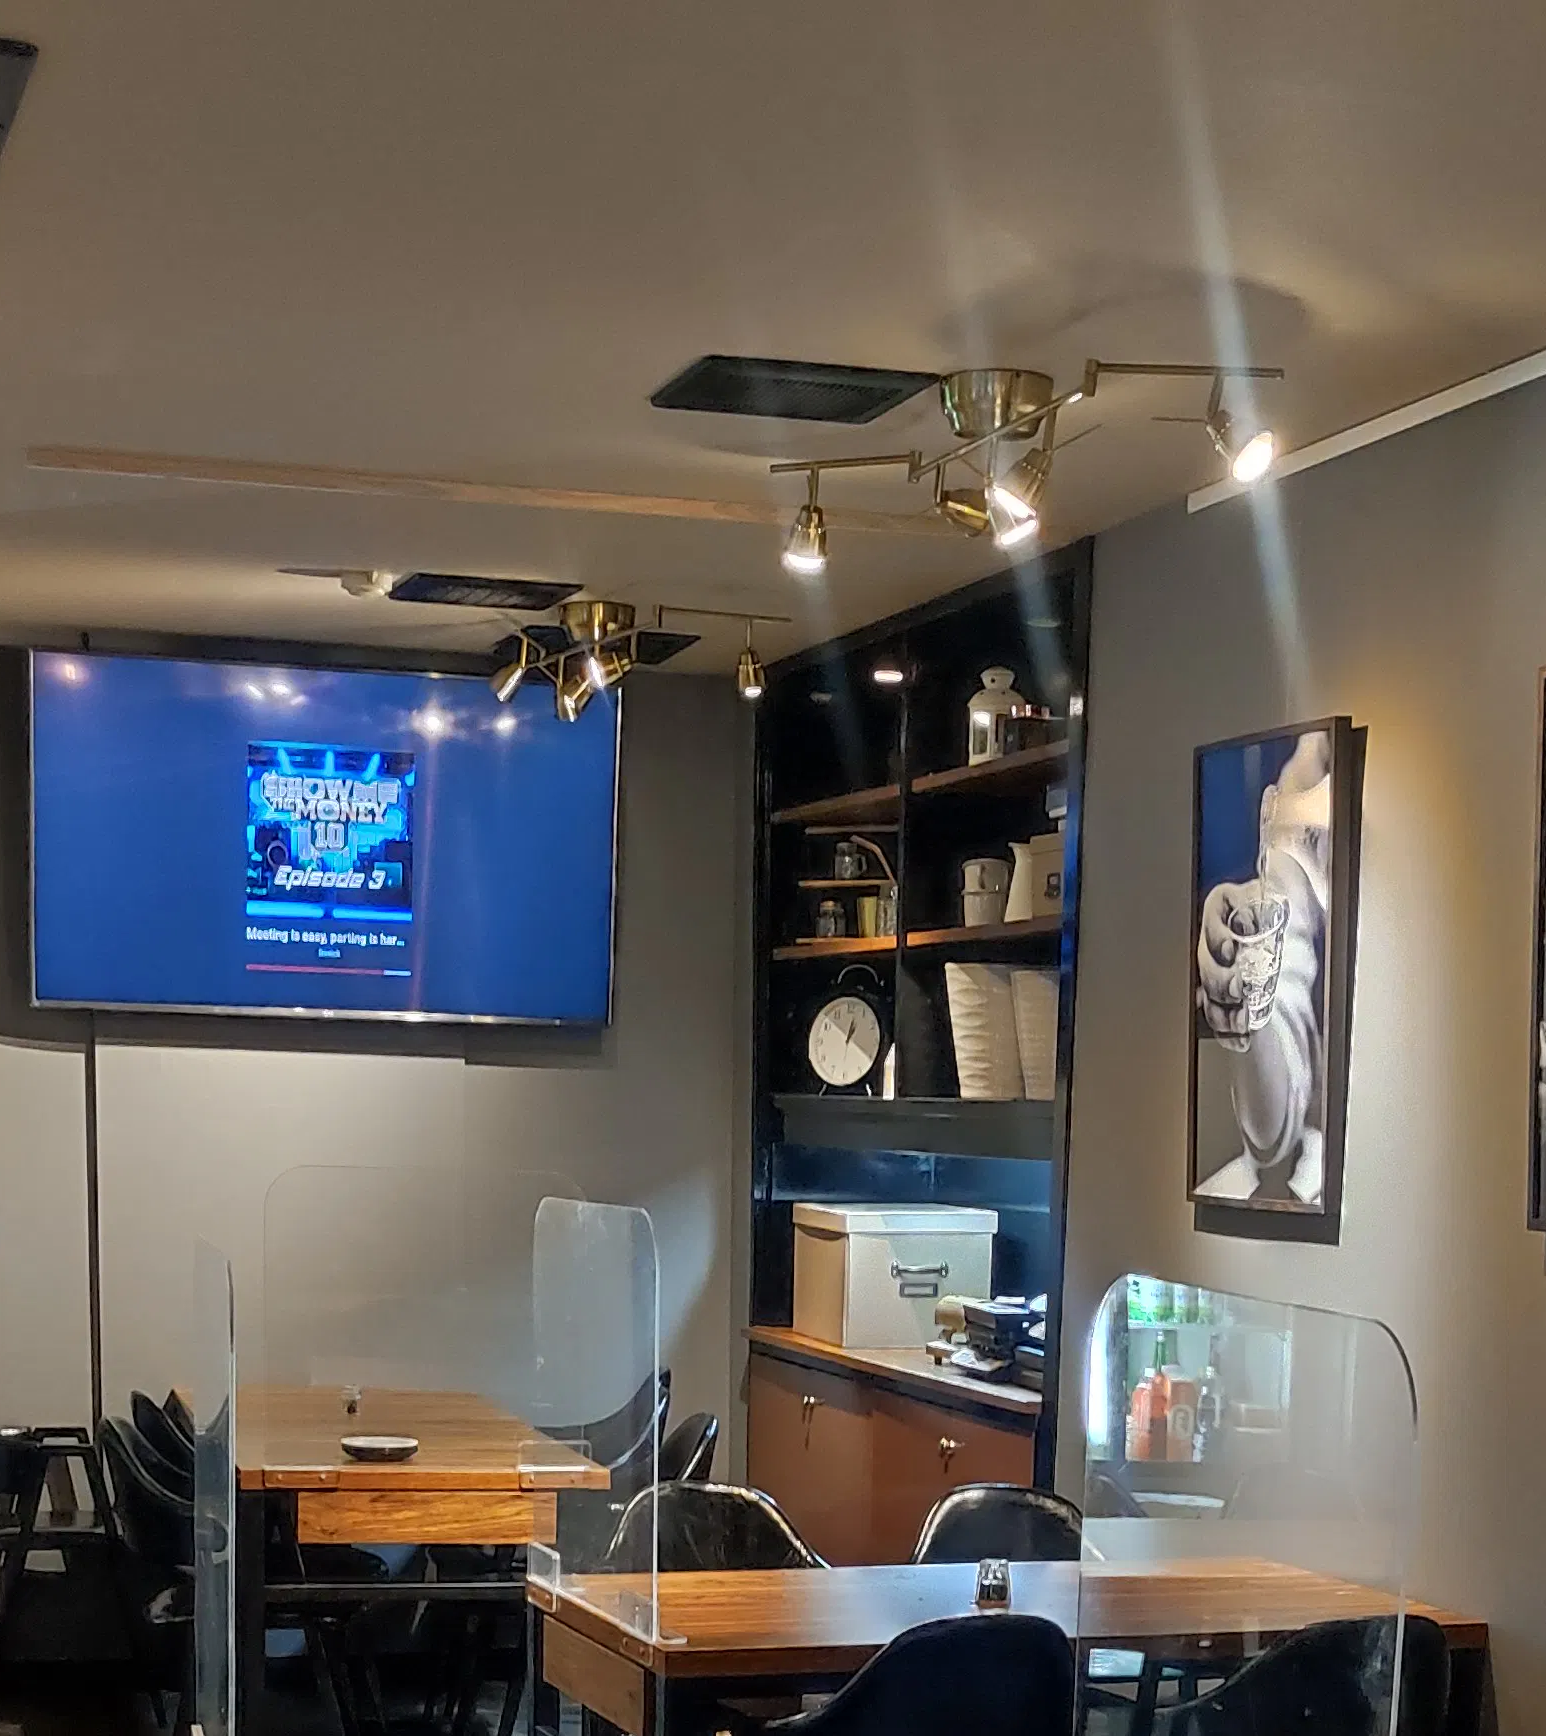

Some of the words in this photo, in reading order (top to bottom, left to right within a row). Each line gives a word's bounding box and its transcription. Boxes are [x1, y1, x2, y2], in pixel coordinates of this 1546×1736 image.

[293, 799, 388, 824] MONEY
[315, 821, 345, 850] 10
[274, 865, 365, 891] Episode
[368, 869, 386, 890] 3
[246, 926, 289, 943] Meeting
[330, 932, 366, 946] parting
